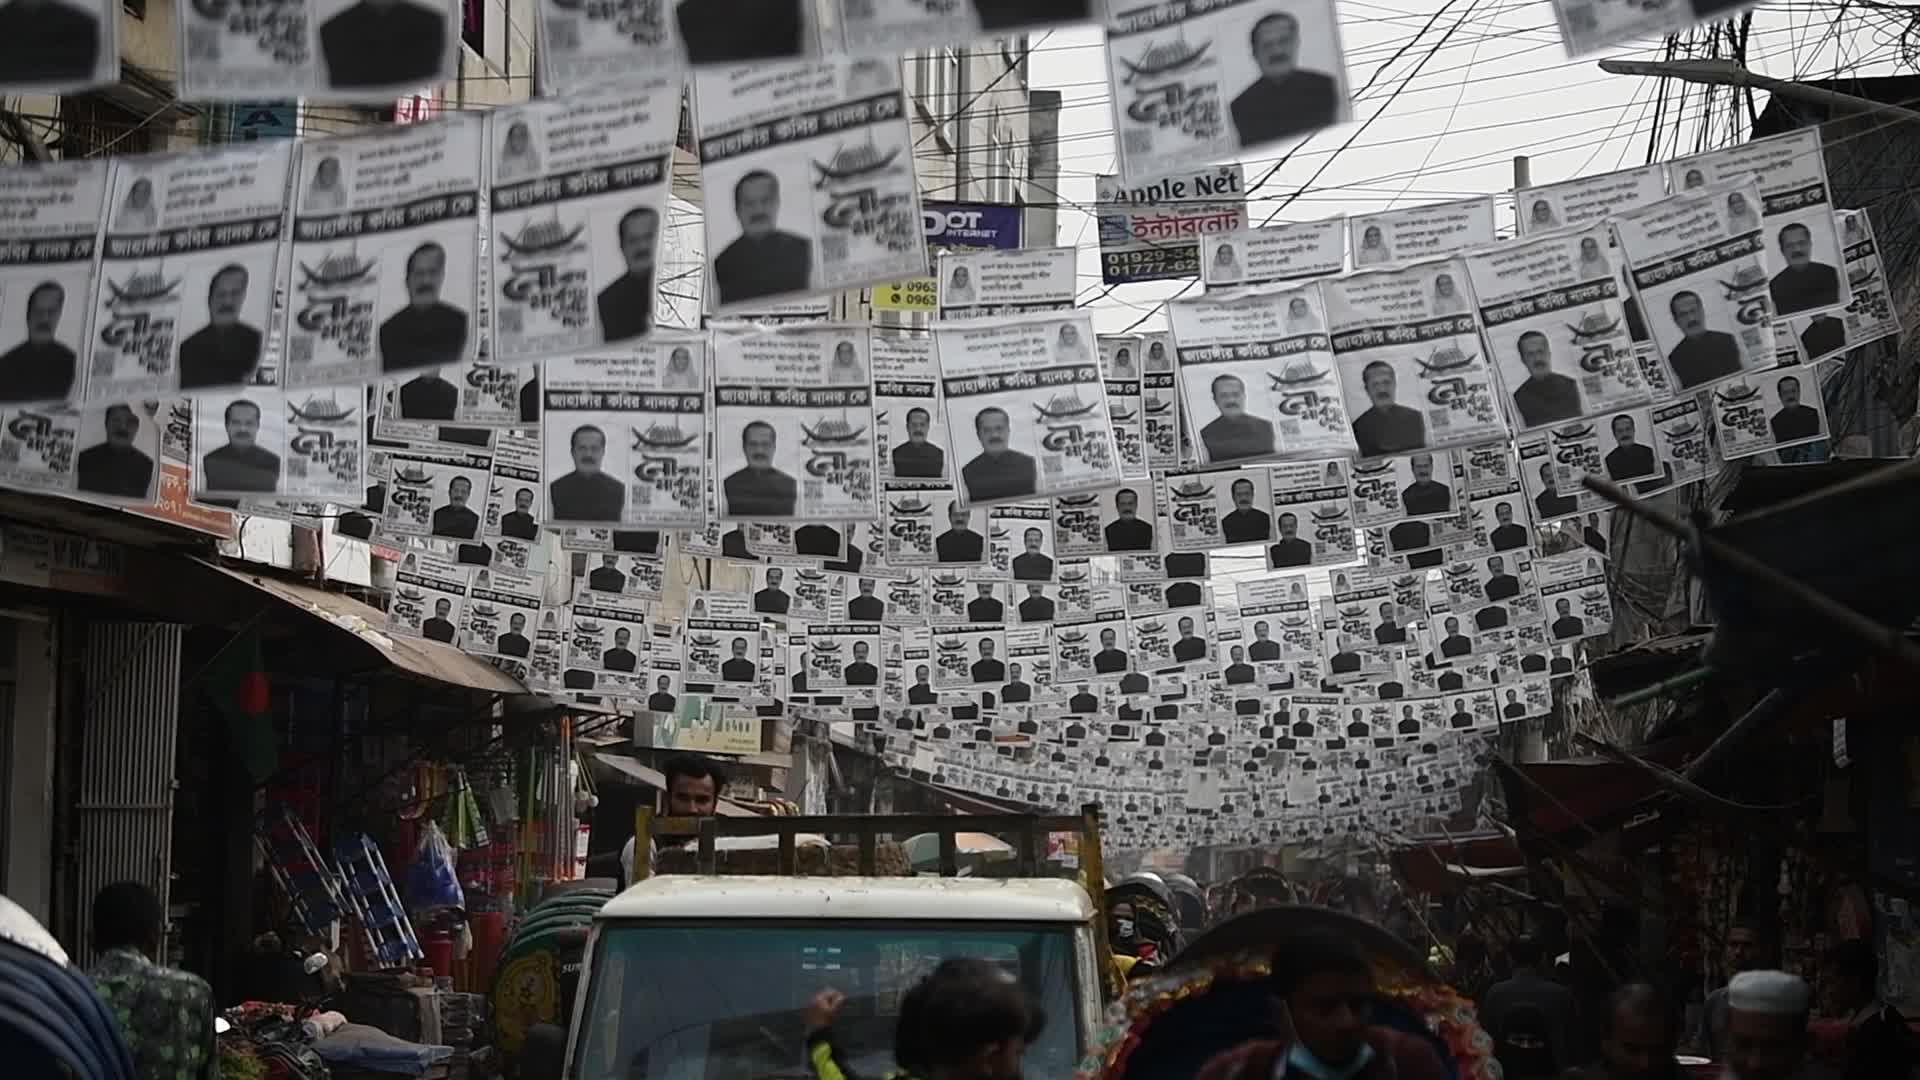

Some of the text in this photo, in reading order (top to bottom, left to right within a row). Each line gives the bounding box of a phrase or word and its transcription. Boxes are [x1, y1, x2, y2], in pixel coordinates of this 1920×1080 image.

[1114, 171, 1240, 206] Apple Net
[921, 210, 983, 236] DOT
[945, 229, 998, 238] INTERNET
[1109, 259, 1200, 276] 01777-62
[1279, 390, 1341, 416] নৌকা
[1428, 377, 1488, 406] নৌকা
[290, 426, 358, 455] নৌকা
[1042, 425, 1107, 452] নৌকা
[634, 454, 700, 482] নৌকা
[806, 449, 870, 478] নৌকা
